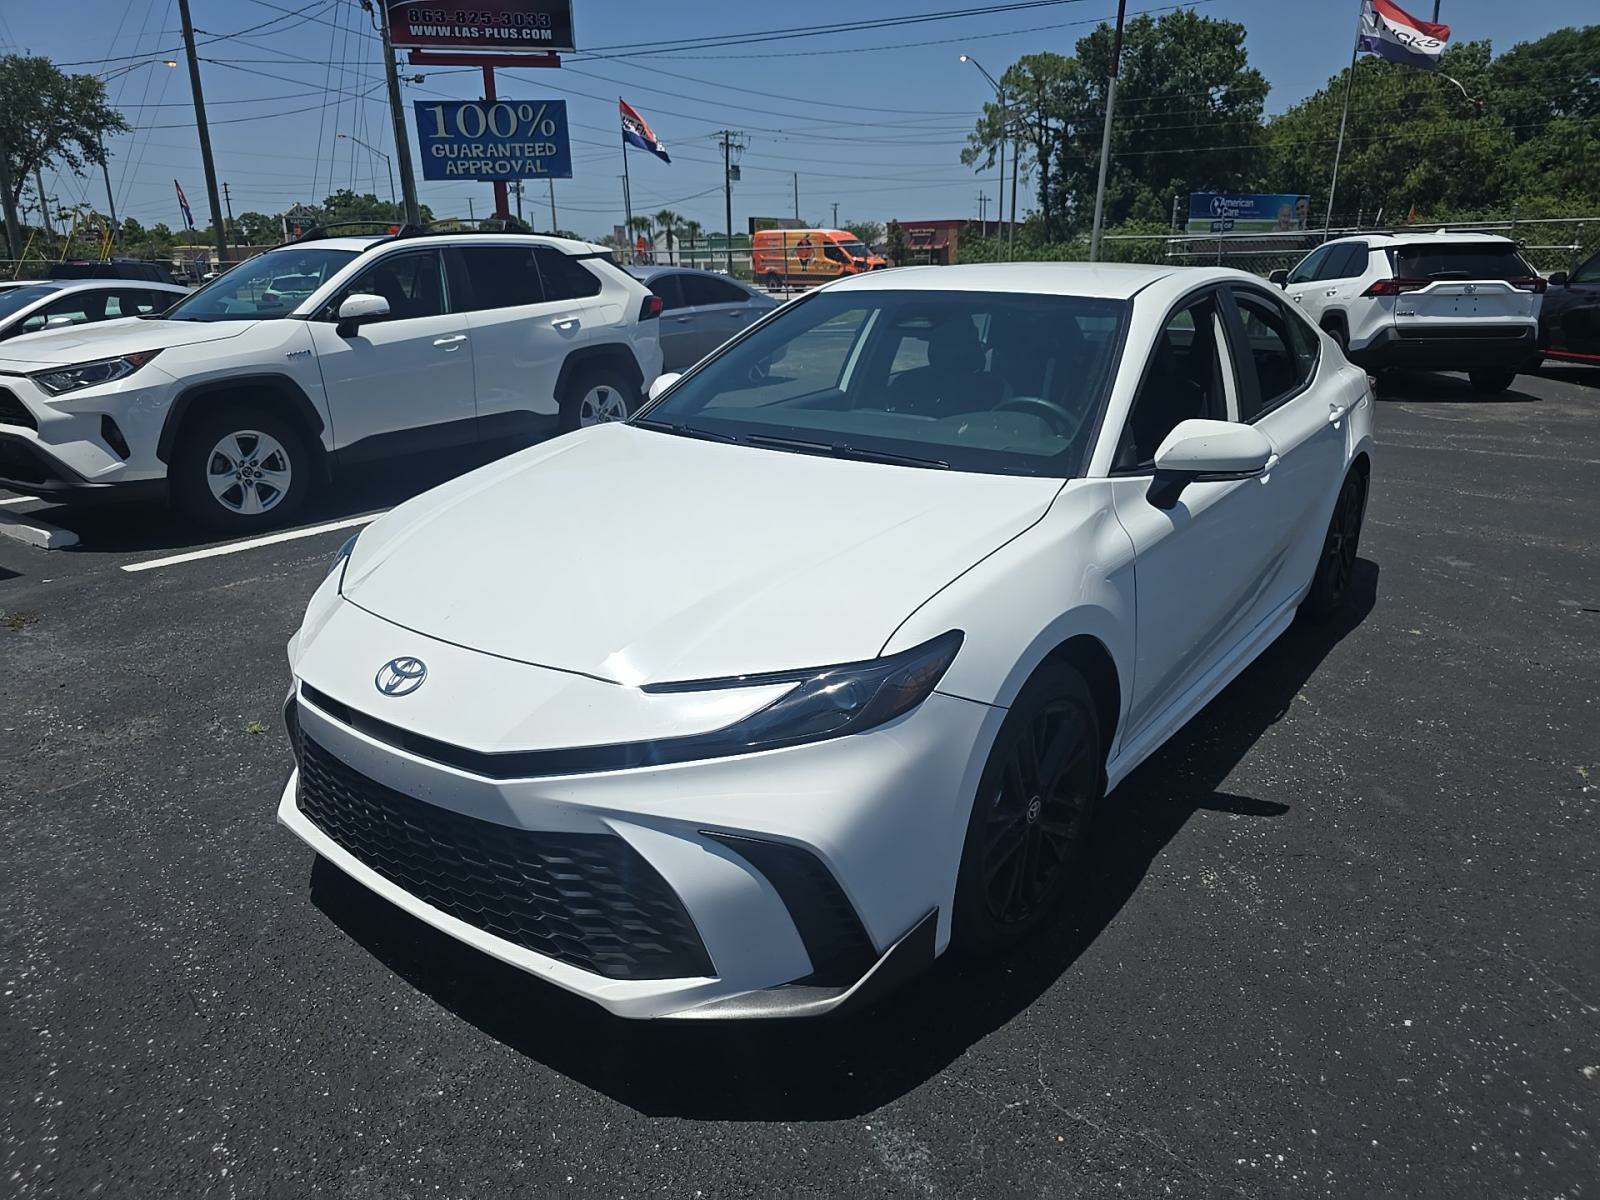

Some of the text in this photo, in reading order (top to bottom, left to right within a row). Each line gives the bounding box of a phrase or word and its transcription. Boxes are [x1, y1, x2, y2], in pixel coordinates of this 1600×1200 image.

[408, 8, 551, 27] 863-825-3033
[409, 25, 552, 40] WWW.LAS-PLUS.COM
[425, 103, 556, 138] 100%
[431, 142, 557, 158] GUARANTEED
[445, 160, 549, 175] APPROVAL
[1220, 198, 1254, 208] American
